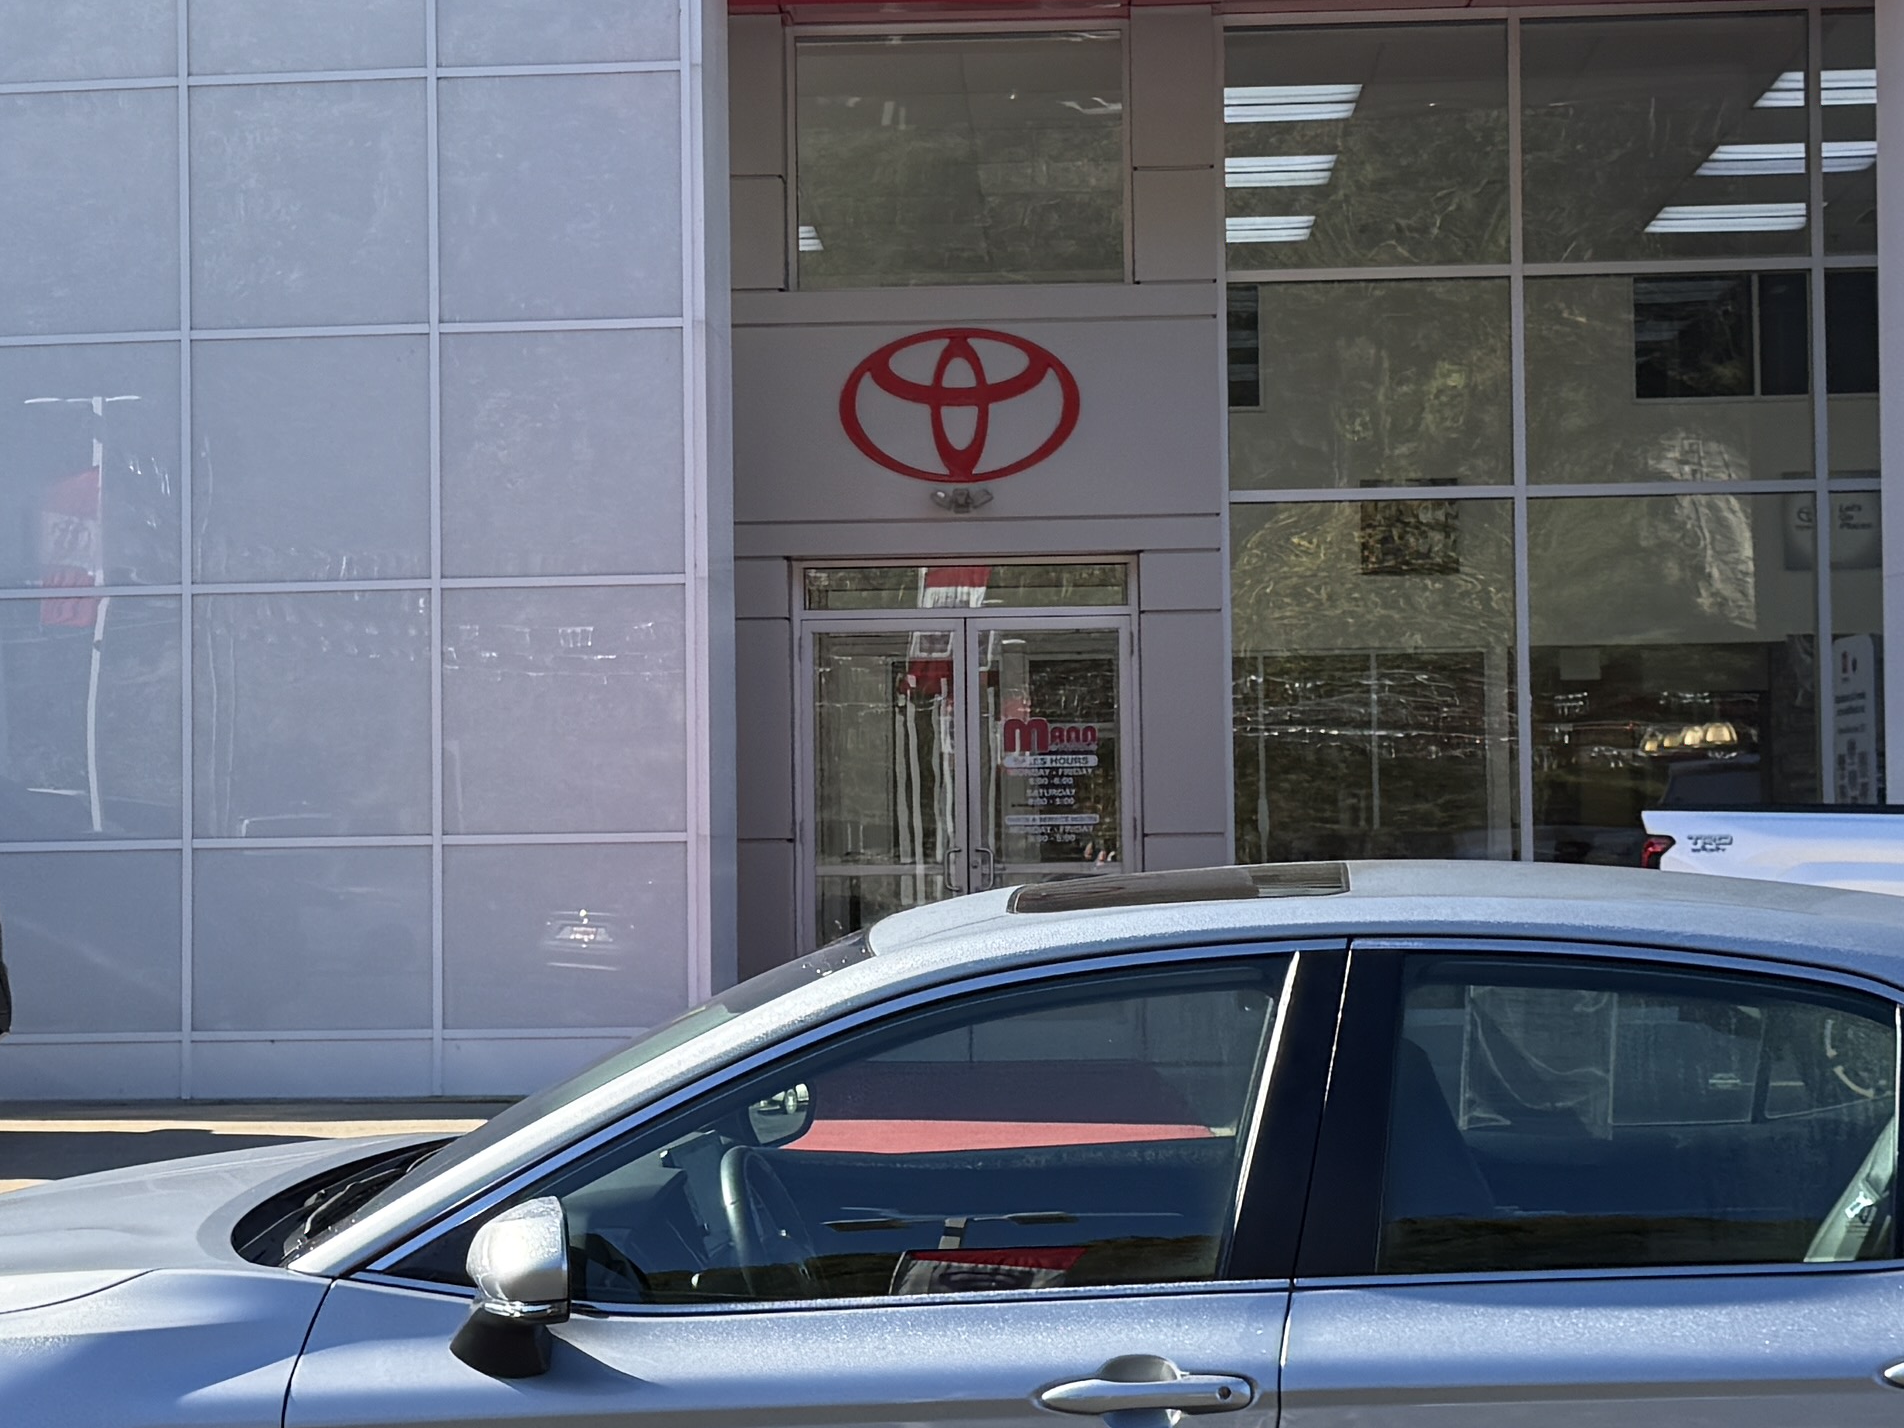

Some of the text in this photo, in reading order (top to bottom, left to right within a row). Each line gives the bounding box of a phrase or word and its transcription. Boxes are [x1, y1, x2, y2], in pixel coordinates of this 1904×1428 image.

[1049, 756, 1089, 766] HOURS
[1026, 788, 1076, 797] SATURDAY
[1686, 834, 1734, 846] TRD
